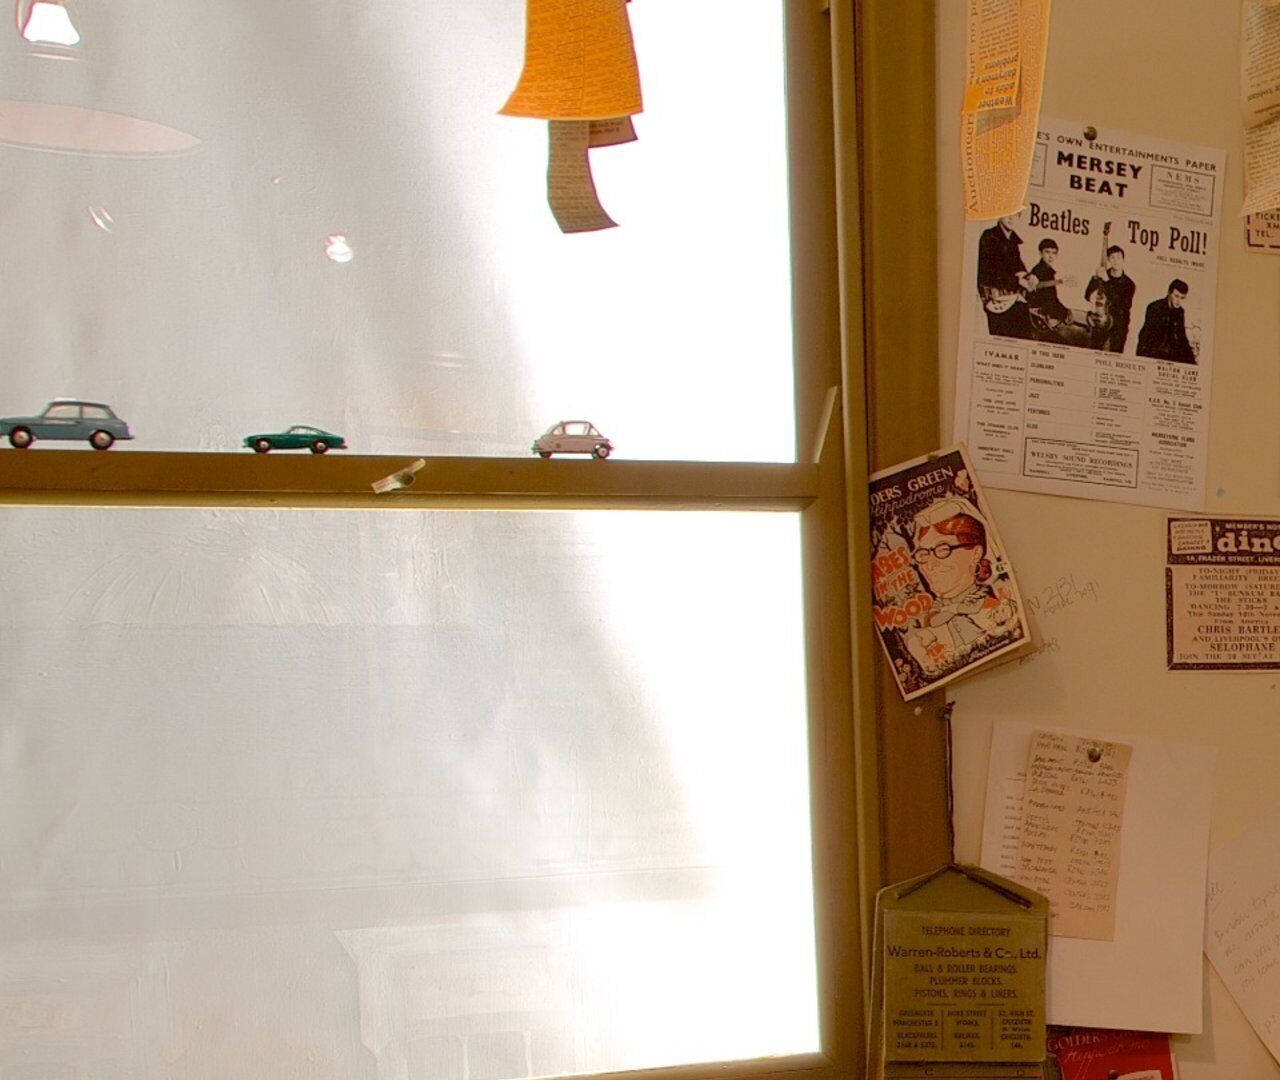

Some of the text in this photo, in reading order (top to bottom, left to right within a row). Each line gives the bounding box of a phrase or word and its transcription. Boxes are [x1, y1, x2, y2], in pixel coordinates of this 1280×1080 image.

[1057, 135, 1217, 172] OWN ENTERTAINMENTS PAPER
[1057, 151, 1143, 179] MERSEY
[1069, 174, 1128, 198] BEAT
[1028, 202, 1208, 255] Beatles Top Poll!
[908, 466, 954, 492] GREEN
[873, 594, 933, 630] WOOD
[1197, 625, 1232, 634] CHRIS
[1210, 643, 1276, 652] SELOPHANE
[922, 927, 1011, 936] TELEPHONE DIRECTORY
[888, 946, 981, 958] Warren-Roberts
